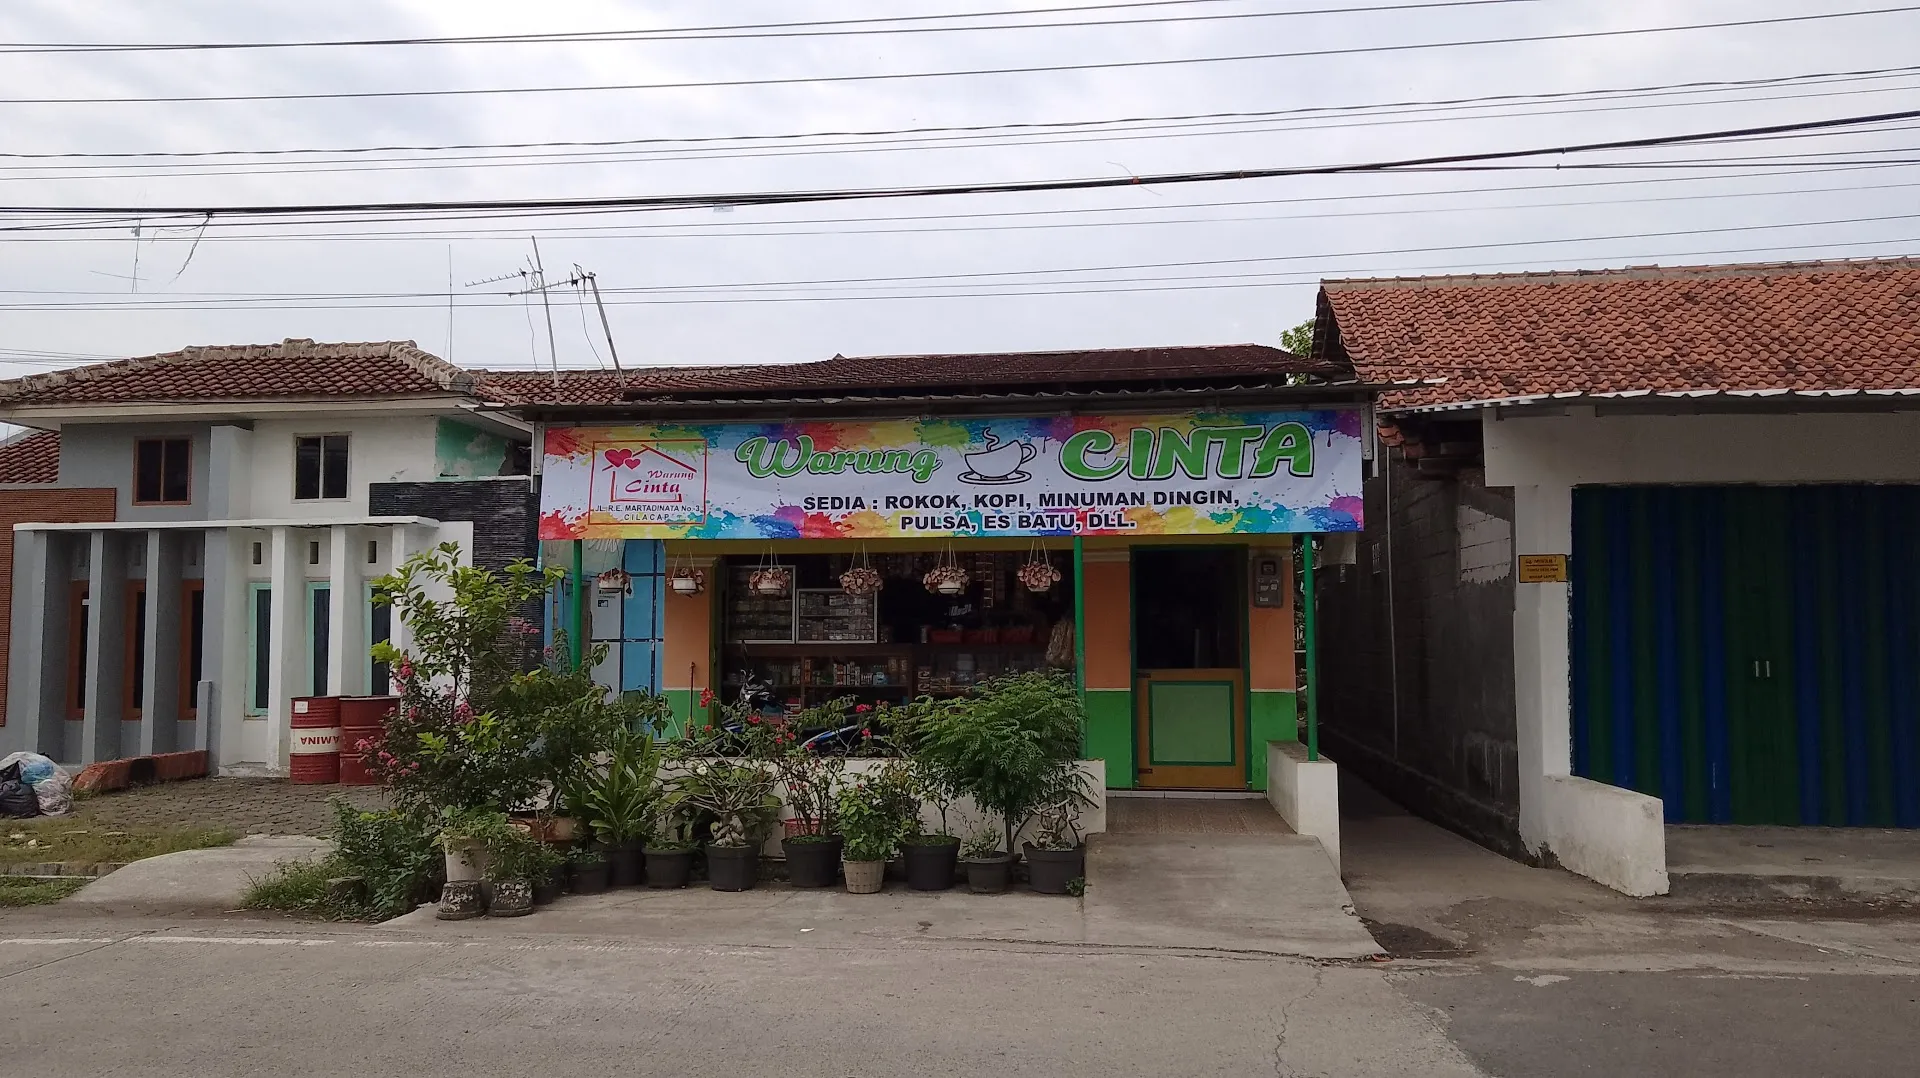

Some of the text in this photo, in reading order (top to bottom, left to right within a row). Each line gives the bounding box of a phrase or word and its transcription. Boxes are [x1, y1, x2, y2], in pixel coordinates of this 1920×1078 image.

[734, 421, 1314, 483] Warung CINTA
[647, 470, 694, 480] Warung
[625, 480, 680, 493] Cinta
[803, 496, 865, 510] SEDIA
[885, 494, 967, 511] ROKOK,
[974, 493, 1031, 511] KOPI,
[1039, 492, 1145, 507] MINUMAN
[1151, 490, 1239, 508] DINGIN,
[624, 513, 670, 521] CILACAP
[901, 513, 1136, 532] PULSA, ES BATU, DLL.
